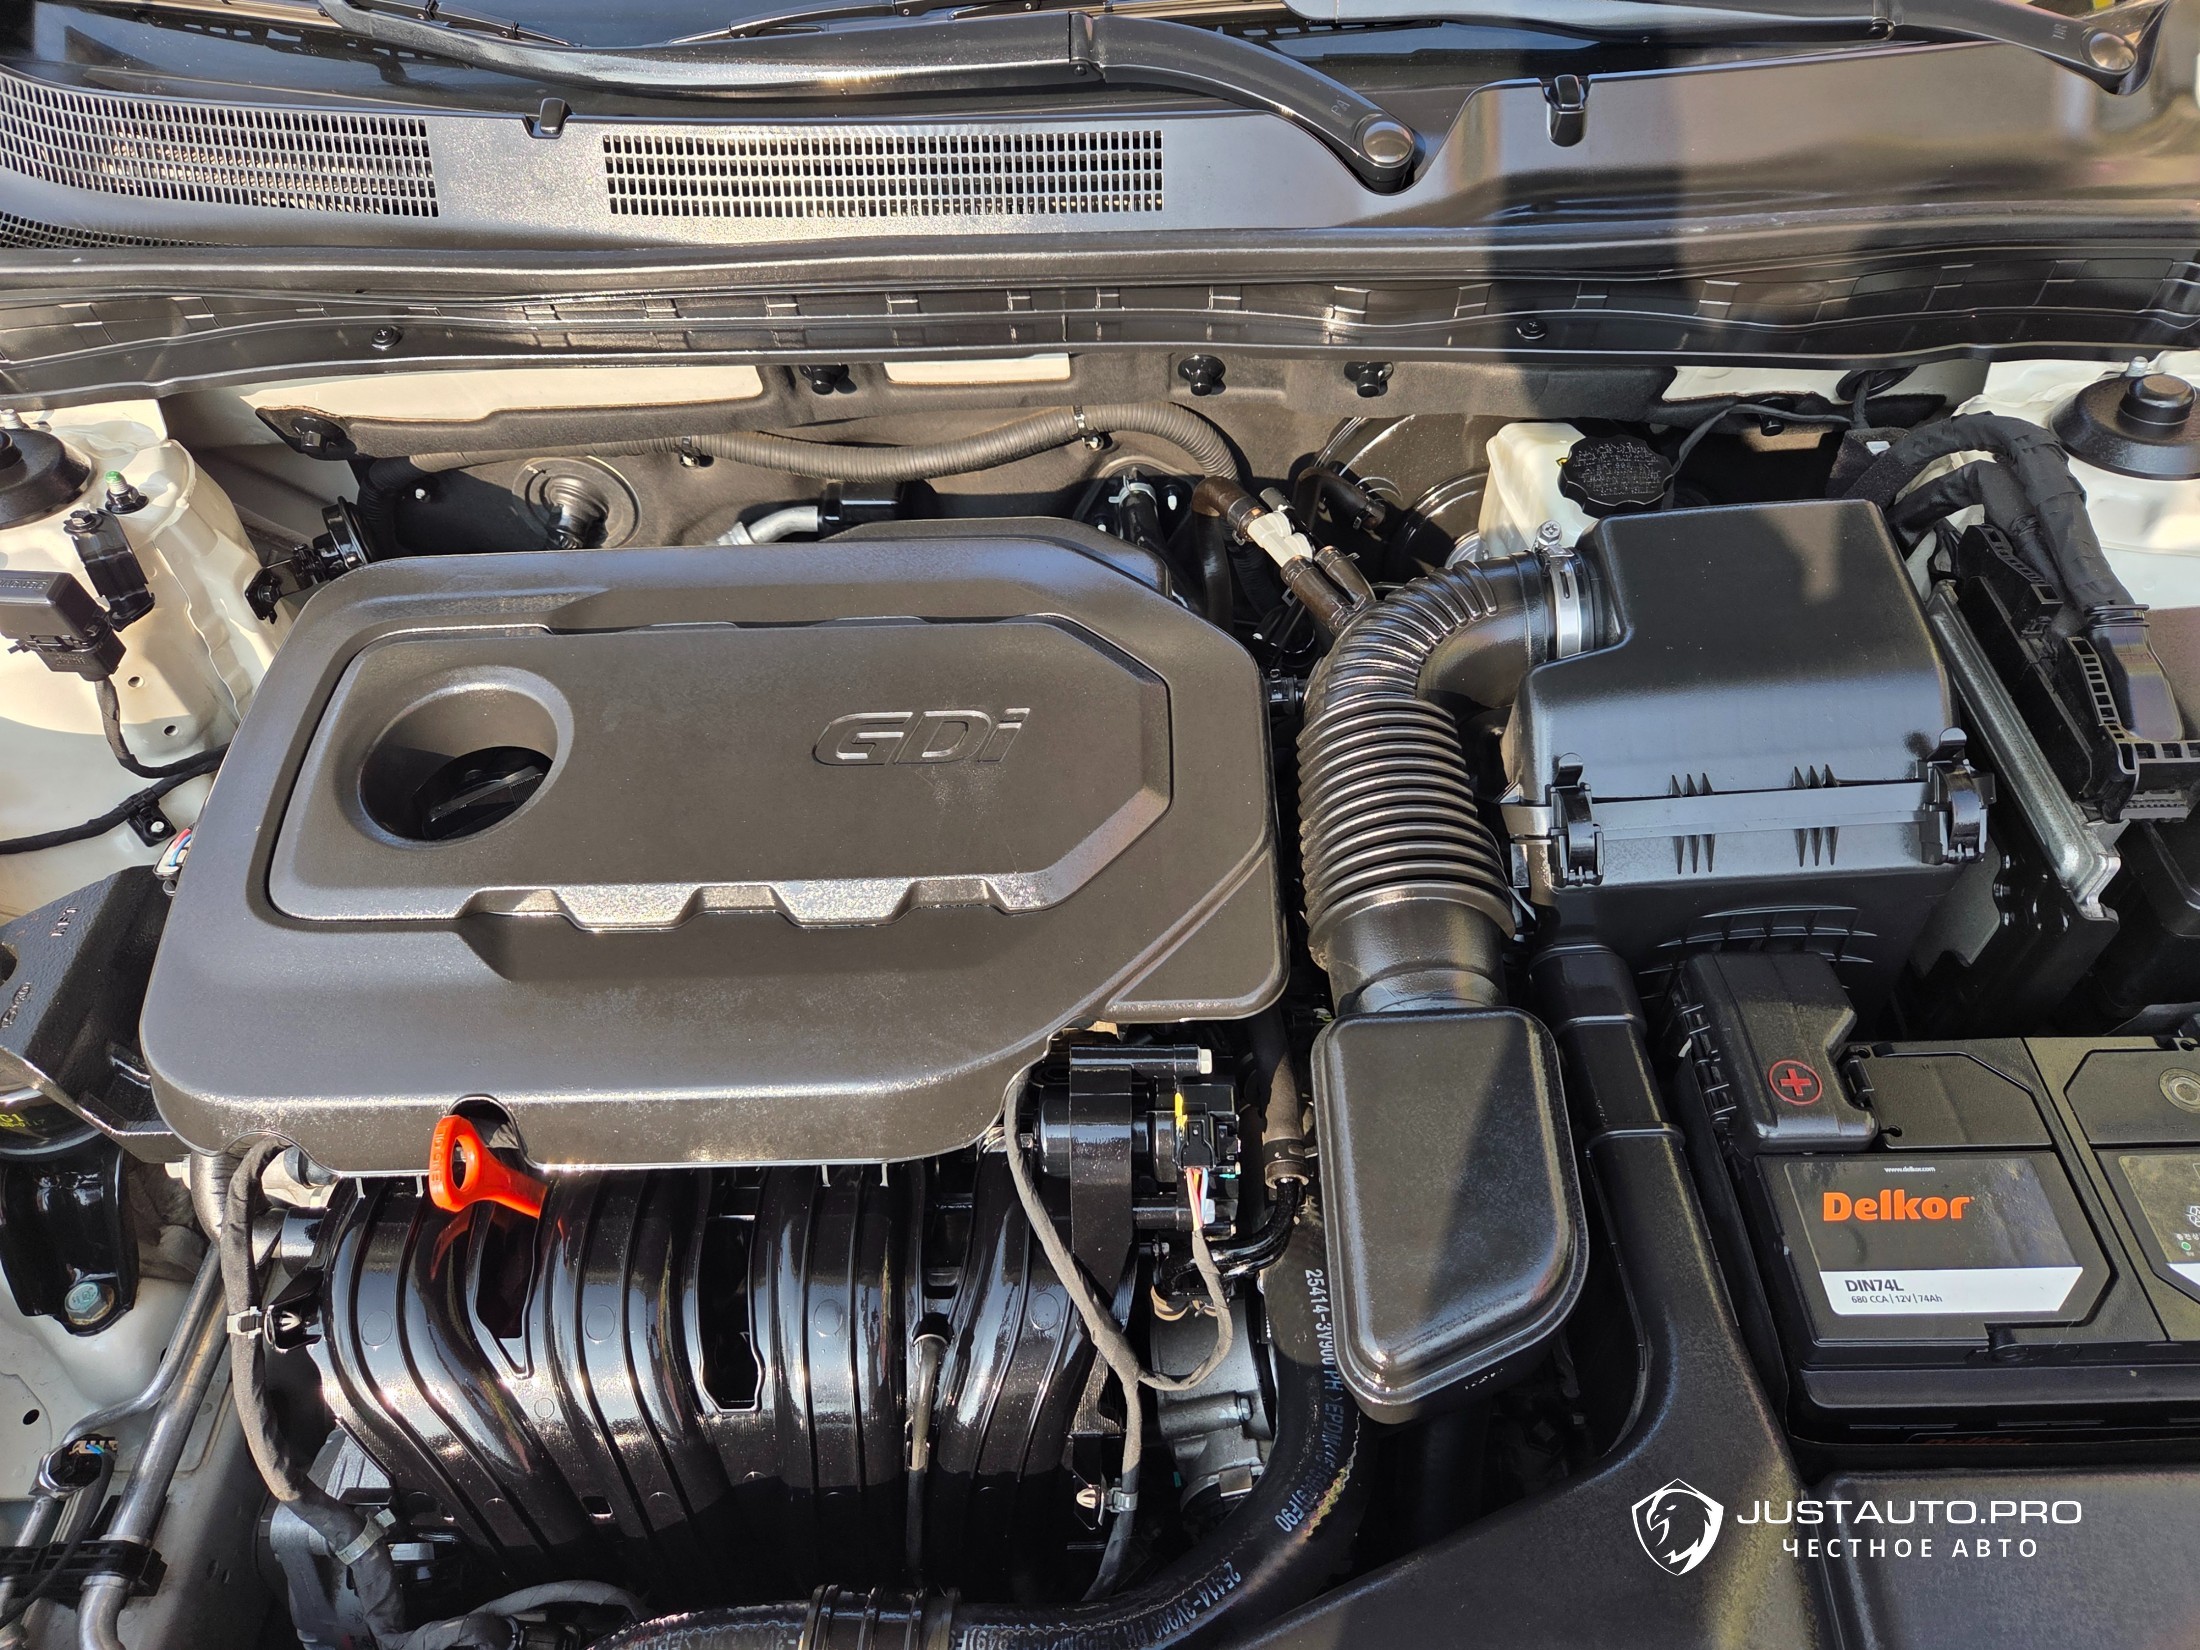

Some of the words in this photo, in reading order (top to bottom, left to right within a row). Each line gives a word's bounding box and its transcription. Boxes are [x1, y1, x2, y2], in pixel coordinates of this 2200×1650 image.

[812, 708, 1030, 766] GDi
[1823, 1189, 1970, 1222] Delkor
[1844, 1279, 1904, 1292] DIN74L
[1851, 1295, 1868, 1304] 680
[1869, 1295, 1889, 1304] CCA
[1895, 1294, 1912, 1303] 12V
[1918, 1293, 1943, 1303] 74Ah
[1304, 1268, 1336, 1366] 25414-3V900
[1324, 1369, 1344, 1391] PH
